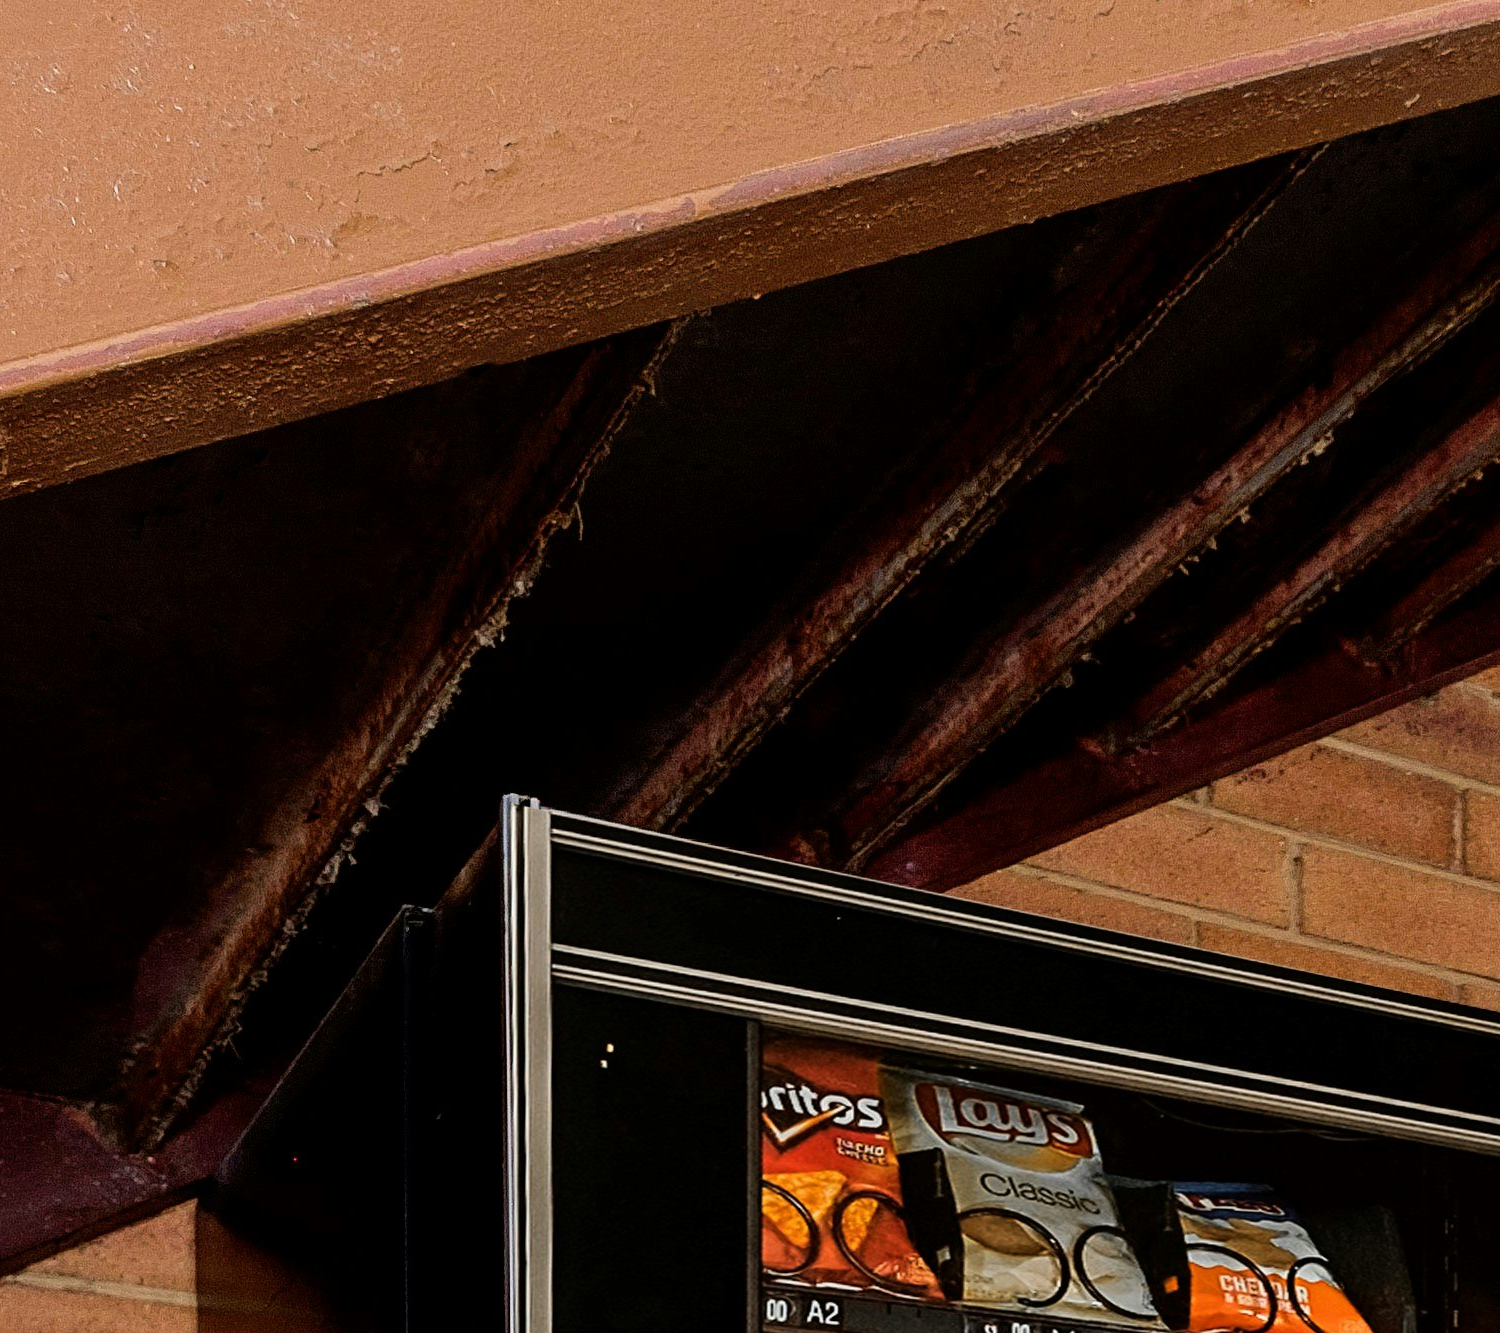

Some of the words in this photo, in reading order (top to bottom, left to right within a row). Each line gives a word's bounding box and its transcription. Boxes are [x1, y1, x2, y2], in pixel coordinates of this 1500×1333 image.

[761, 1083, 884, 1129] ritos
[980, 1173, 1101, 1215] Classic
[806, 1302, 840, 1325] A2
